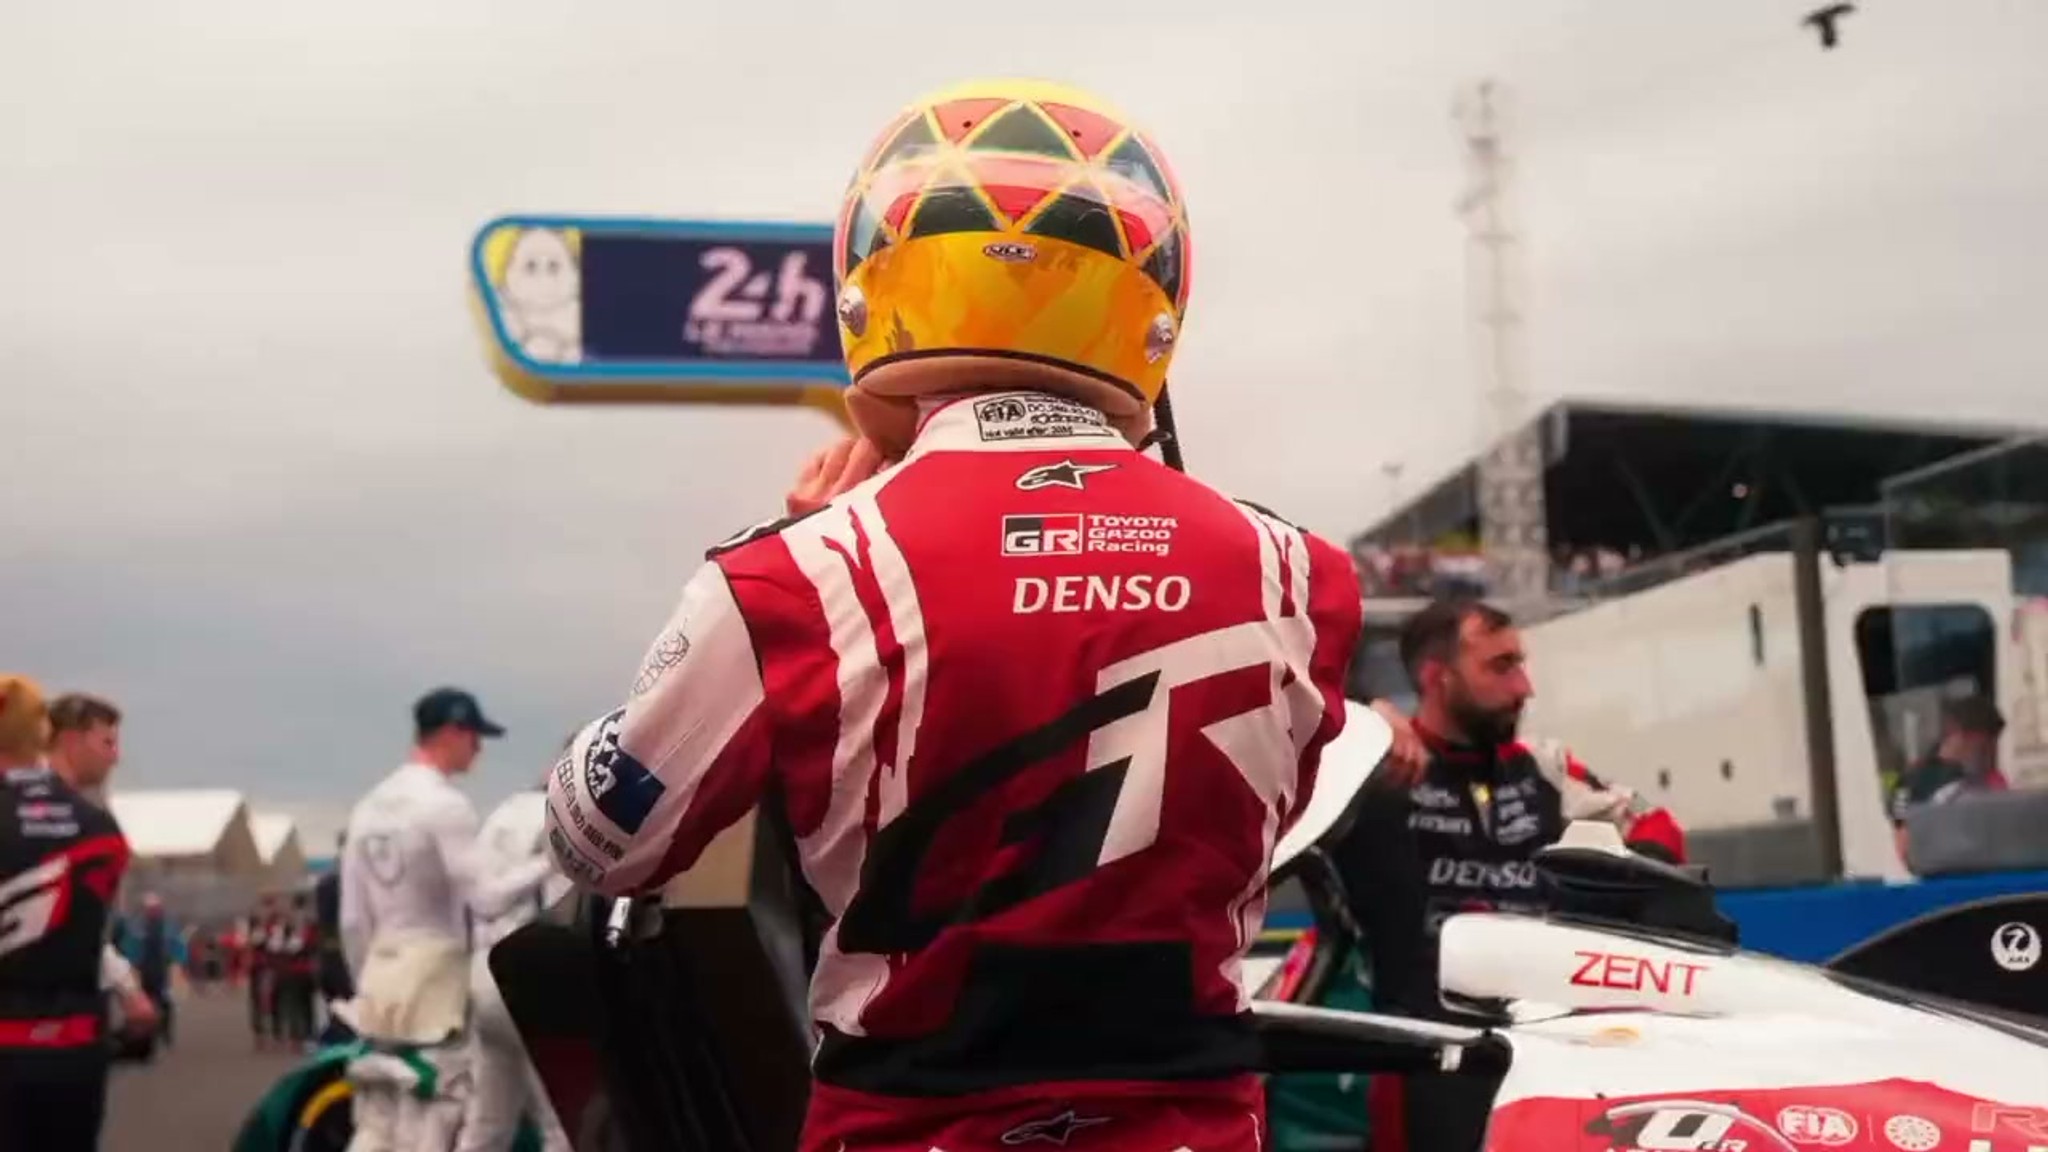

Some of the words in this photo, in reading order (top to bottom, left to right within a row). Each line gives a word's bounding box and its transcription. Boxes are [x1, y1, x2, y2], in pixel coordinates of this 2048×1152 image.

[980, 401, 1023, 422] FIA
[1087, 514, 1178, 528] TOYOTA
[1004, 529, 1080, 553] GR
[1087, 527, 1171, 540] GAZOO
[1087, 540, 1170, 556] Racing
[1013, 574, 1191, 614] DENSO
[1428, 858, 1537, 888] DENSO
[1570, 950, 1712, 996] ZENT
[1782, 1109, 1853, 1140] FIA
